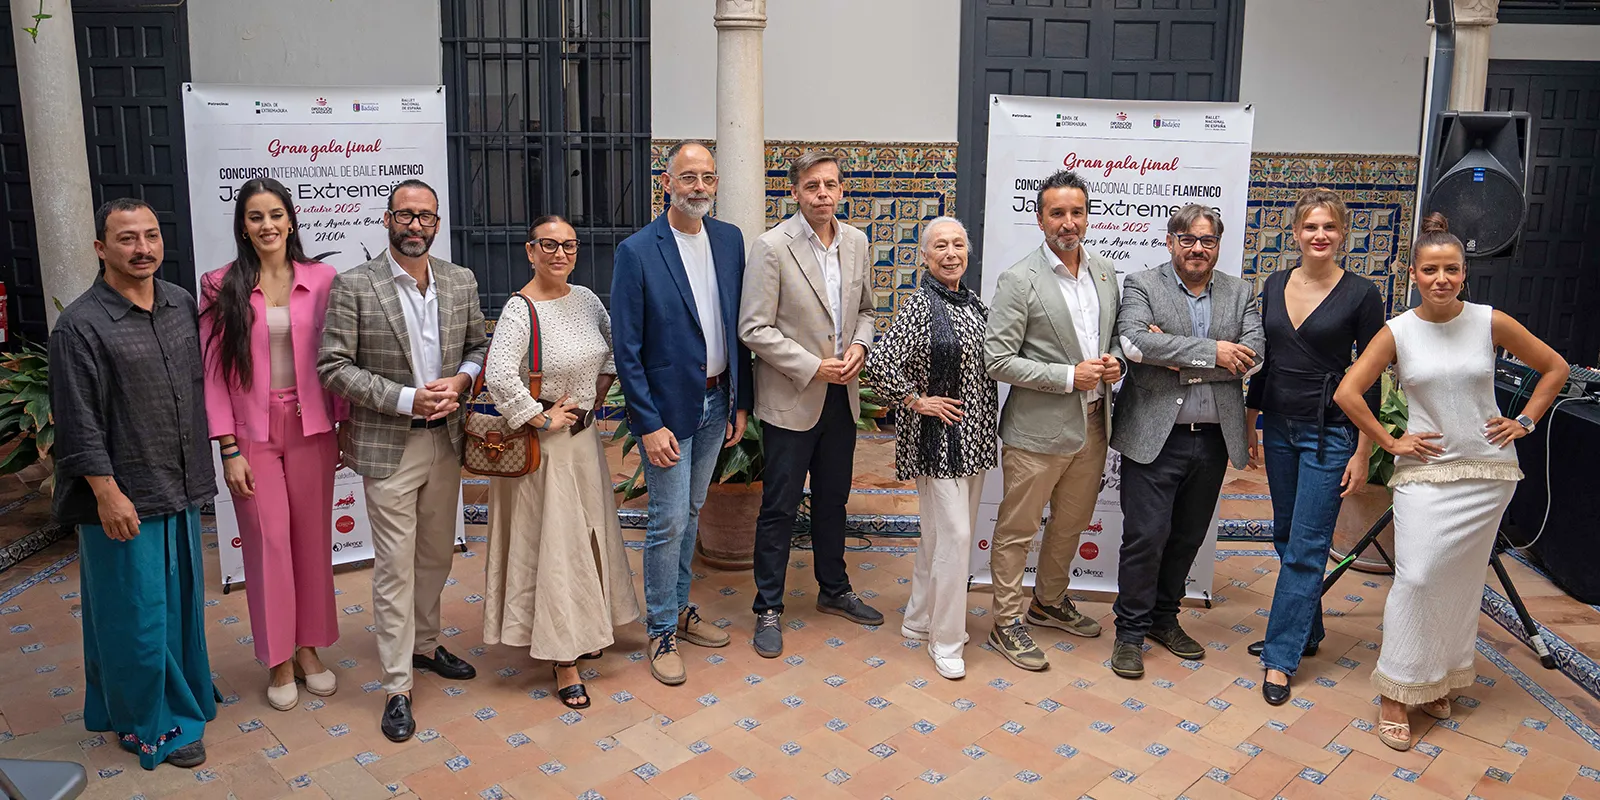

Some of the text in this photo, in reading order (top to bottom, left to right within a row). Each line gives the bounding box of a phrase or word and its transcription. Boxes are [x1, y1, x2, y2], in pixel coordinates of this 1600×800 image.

[268, 138, 382, 162] Gran gala final
[1063, 152, 1180, 177] Gran gala final
[219, 163, 424, 180] CONCURSO INTERNACIONAL DE BAILE FLAMENCO
[1132, 182, 1144, 195] DE
[1146, 183, 1171, 196] BAILE
[1172, 184, 1222, 198] FLAMENCO
[303, 204, 332, 213] octubre
[334, 202, 361, 214] 2025
[313, 220, 322, 228] de
[325, 218, 350, 228] Ayala
[353, 217, 362, 226] de
[364, 217, 384, 226] Bada
[1091, 221, 1120, 231] octubre
[1122, 221, 1151, 233] 2025
[1099, 236, 1108, 245] de
[1110, 236, 1137, 247] Ayala
[1139, 239, 1149, 247] de
[342, 540, 363, 548] silence
[1083, 568, 1104, 576] silence
